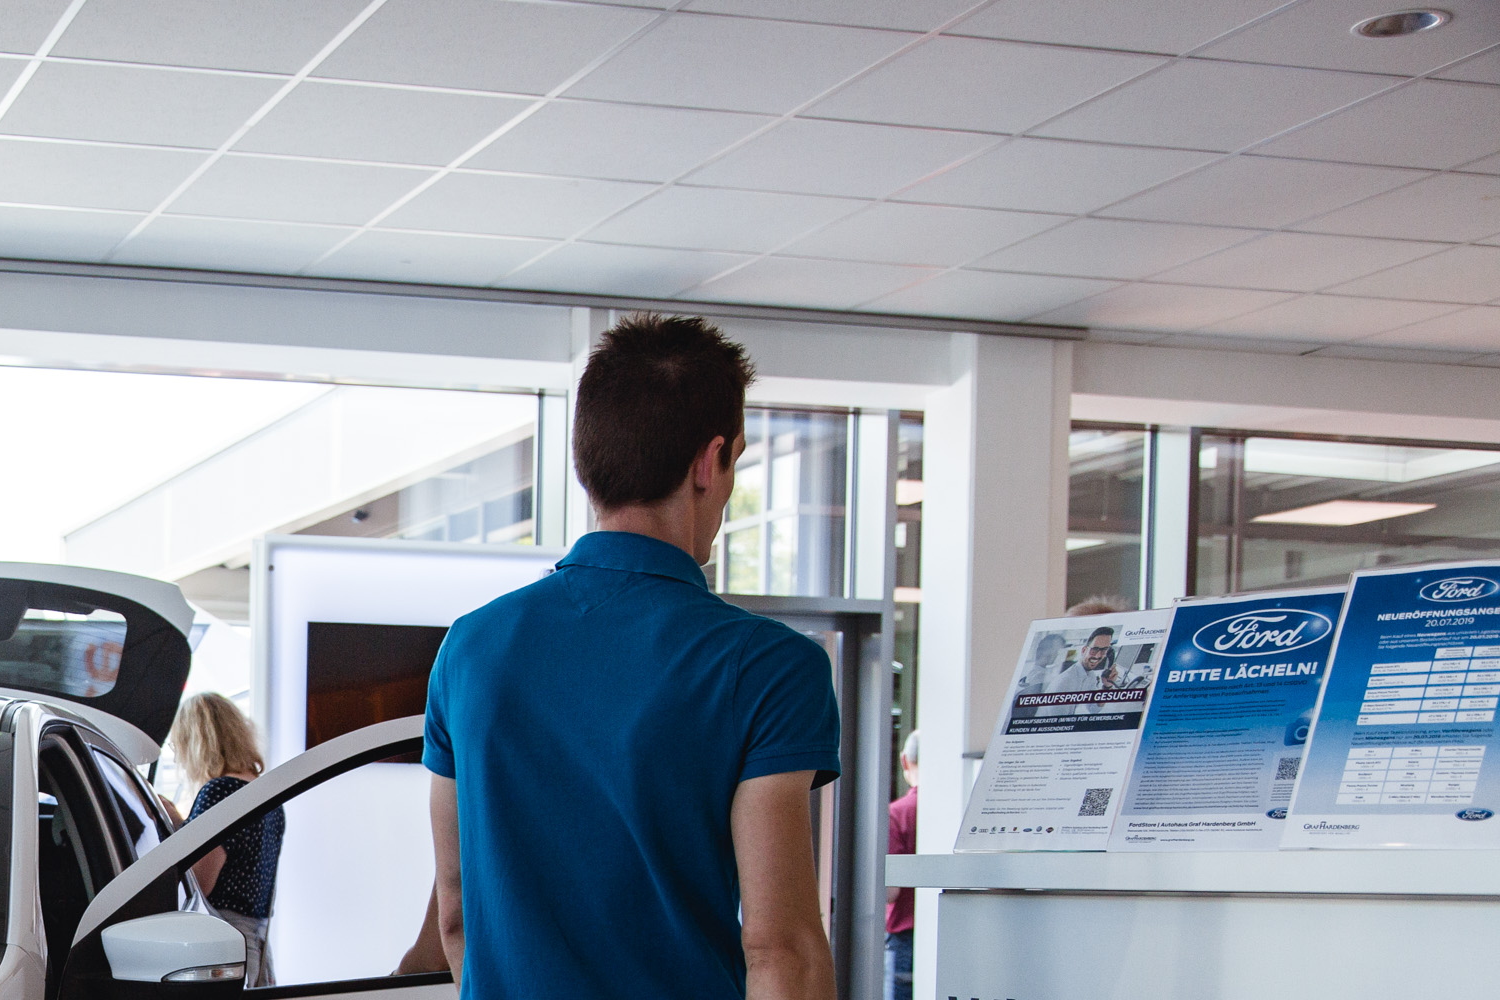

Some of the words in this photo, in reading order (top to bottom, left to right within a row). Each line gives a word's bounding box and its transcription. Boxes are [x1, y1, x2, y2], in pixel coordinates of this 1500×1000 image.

[1431, 579, 1485, 599] Ford
[1425, 617, 1475, 628] 20.07.2019
[1214, 615, 1309, 650] Ford
[1167, 668, 1222, 683] BITTE
[1224, 662, 1318, 680] LÄCHELN!
[1019, 692, 1092, 706] VERKAUFSPROFI
[1094, 690, 1143, 701] GESUCHT!
[1462, 810, 1488, 819] Ford
